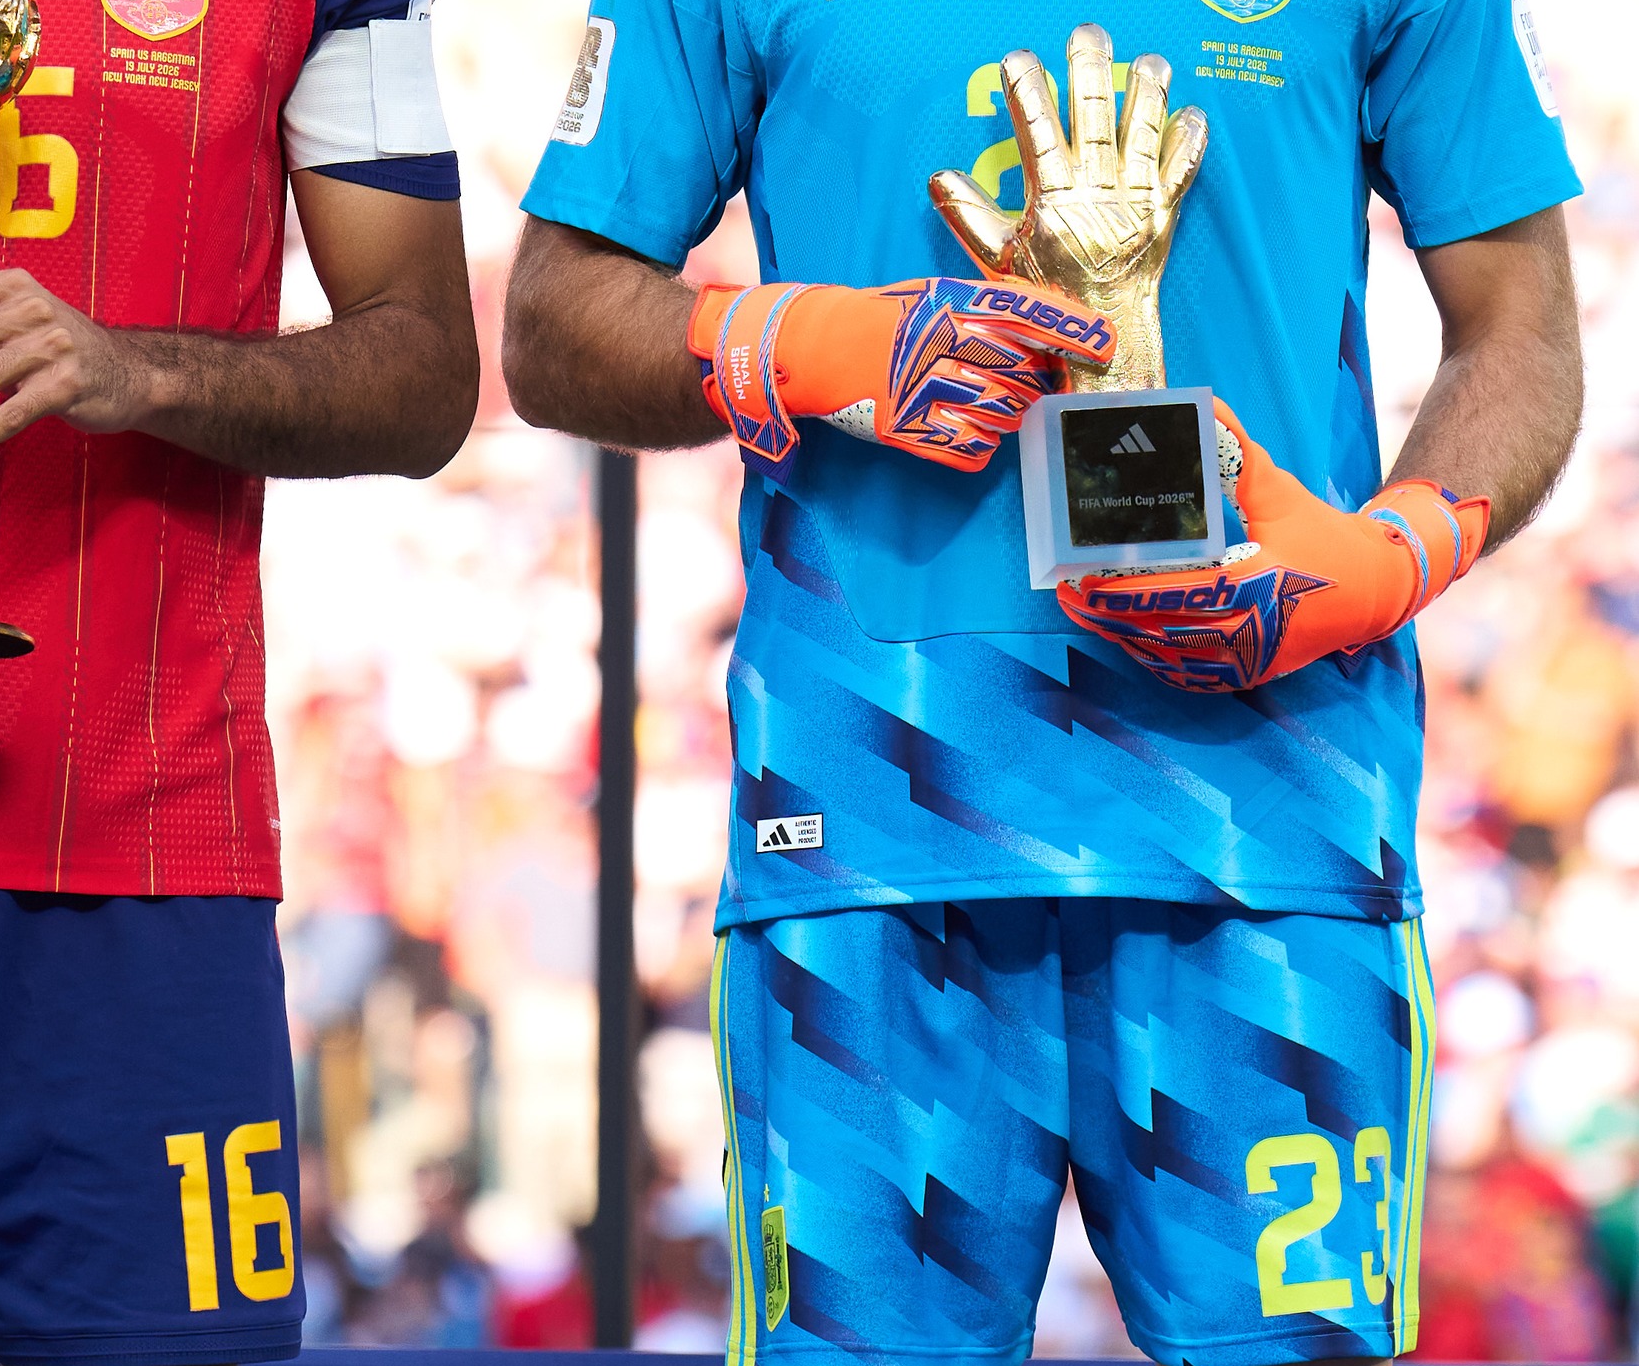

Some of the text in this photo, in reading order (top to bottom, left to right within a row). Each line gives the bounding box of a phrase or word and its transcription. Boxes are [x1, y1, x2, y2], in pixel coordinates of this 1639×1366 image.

[110, 47, 135, 59] SPAIN
[151, 51, 195, 67] ARGENTINA
[1202, 40, 1225, 53] SPAIN
[1240, 44, 1283, 61] ARGENTINA
[125, 60, 180, 77] 19 JULY 2026
[1216, 54, 1267, 71] 19 JULY 2026
[103, 71, 200, 92] NEW YORK NEW JERSEY
[1195, 65, 1285, 88] NEW YORK NEW JERSEY
[972, 287, 1112, 350] reusch
[740, 345, 751, 385] UNAI
[1079, 497, 1100, 510] FIFA
[1102, 495, 1132, 508] World
[1135, 495, 1155, 509] Cup
[1087, 576, 1237, 612] reusch
[165, 1120, 295, 1311] 16
[1246, 1125, 1393, 1318] 23
